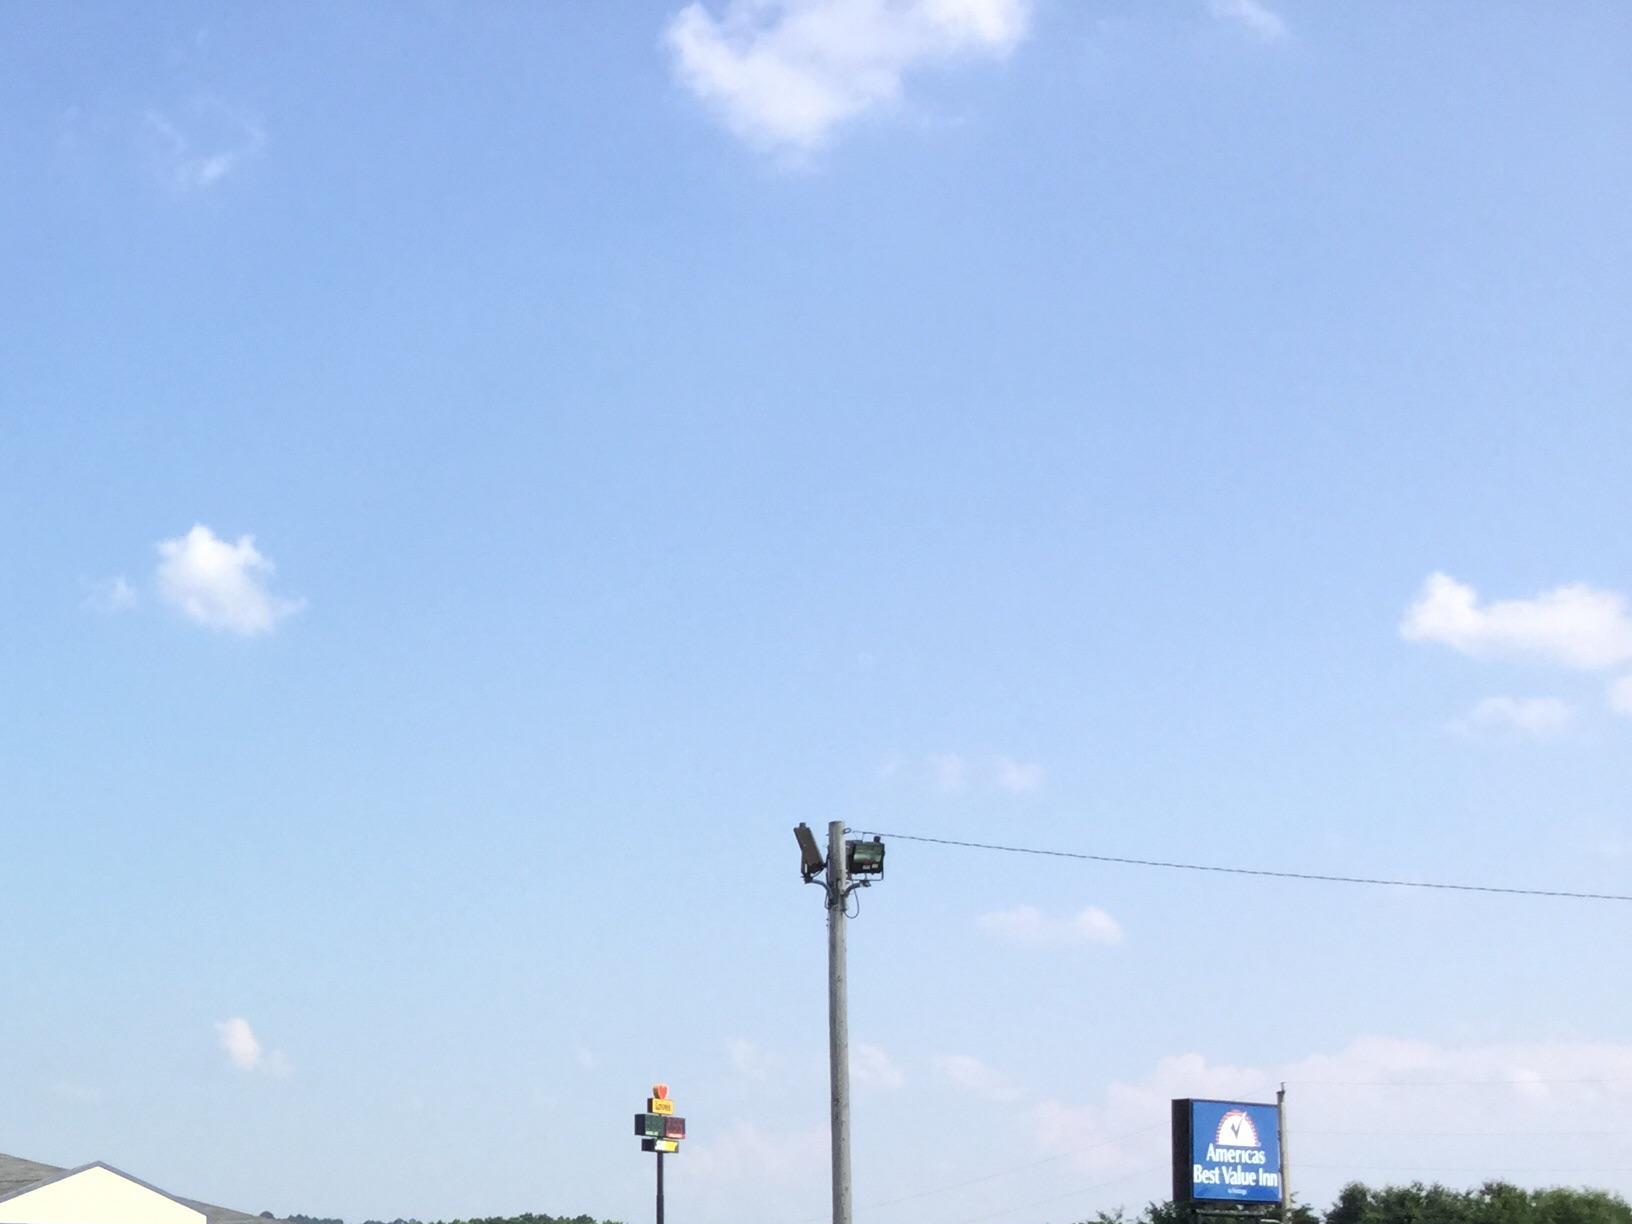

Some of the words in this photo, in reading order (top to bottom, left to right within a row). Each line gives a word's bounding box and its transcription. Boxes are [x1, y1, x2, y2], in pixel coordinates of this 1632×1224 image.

[1193, 1163, 1220, 1184] Best
[1222, 1166, 1256, 1186] Value
[1258, 1168, 1278, 1187] Inn
